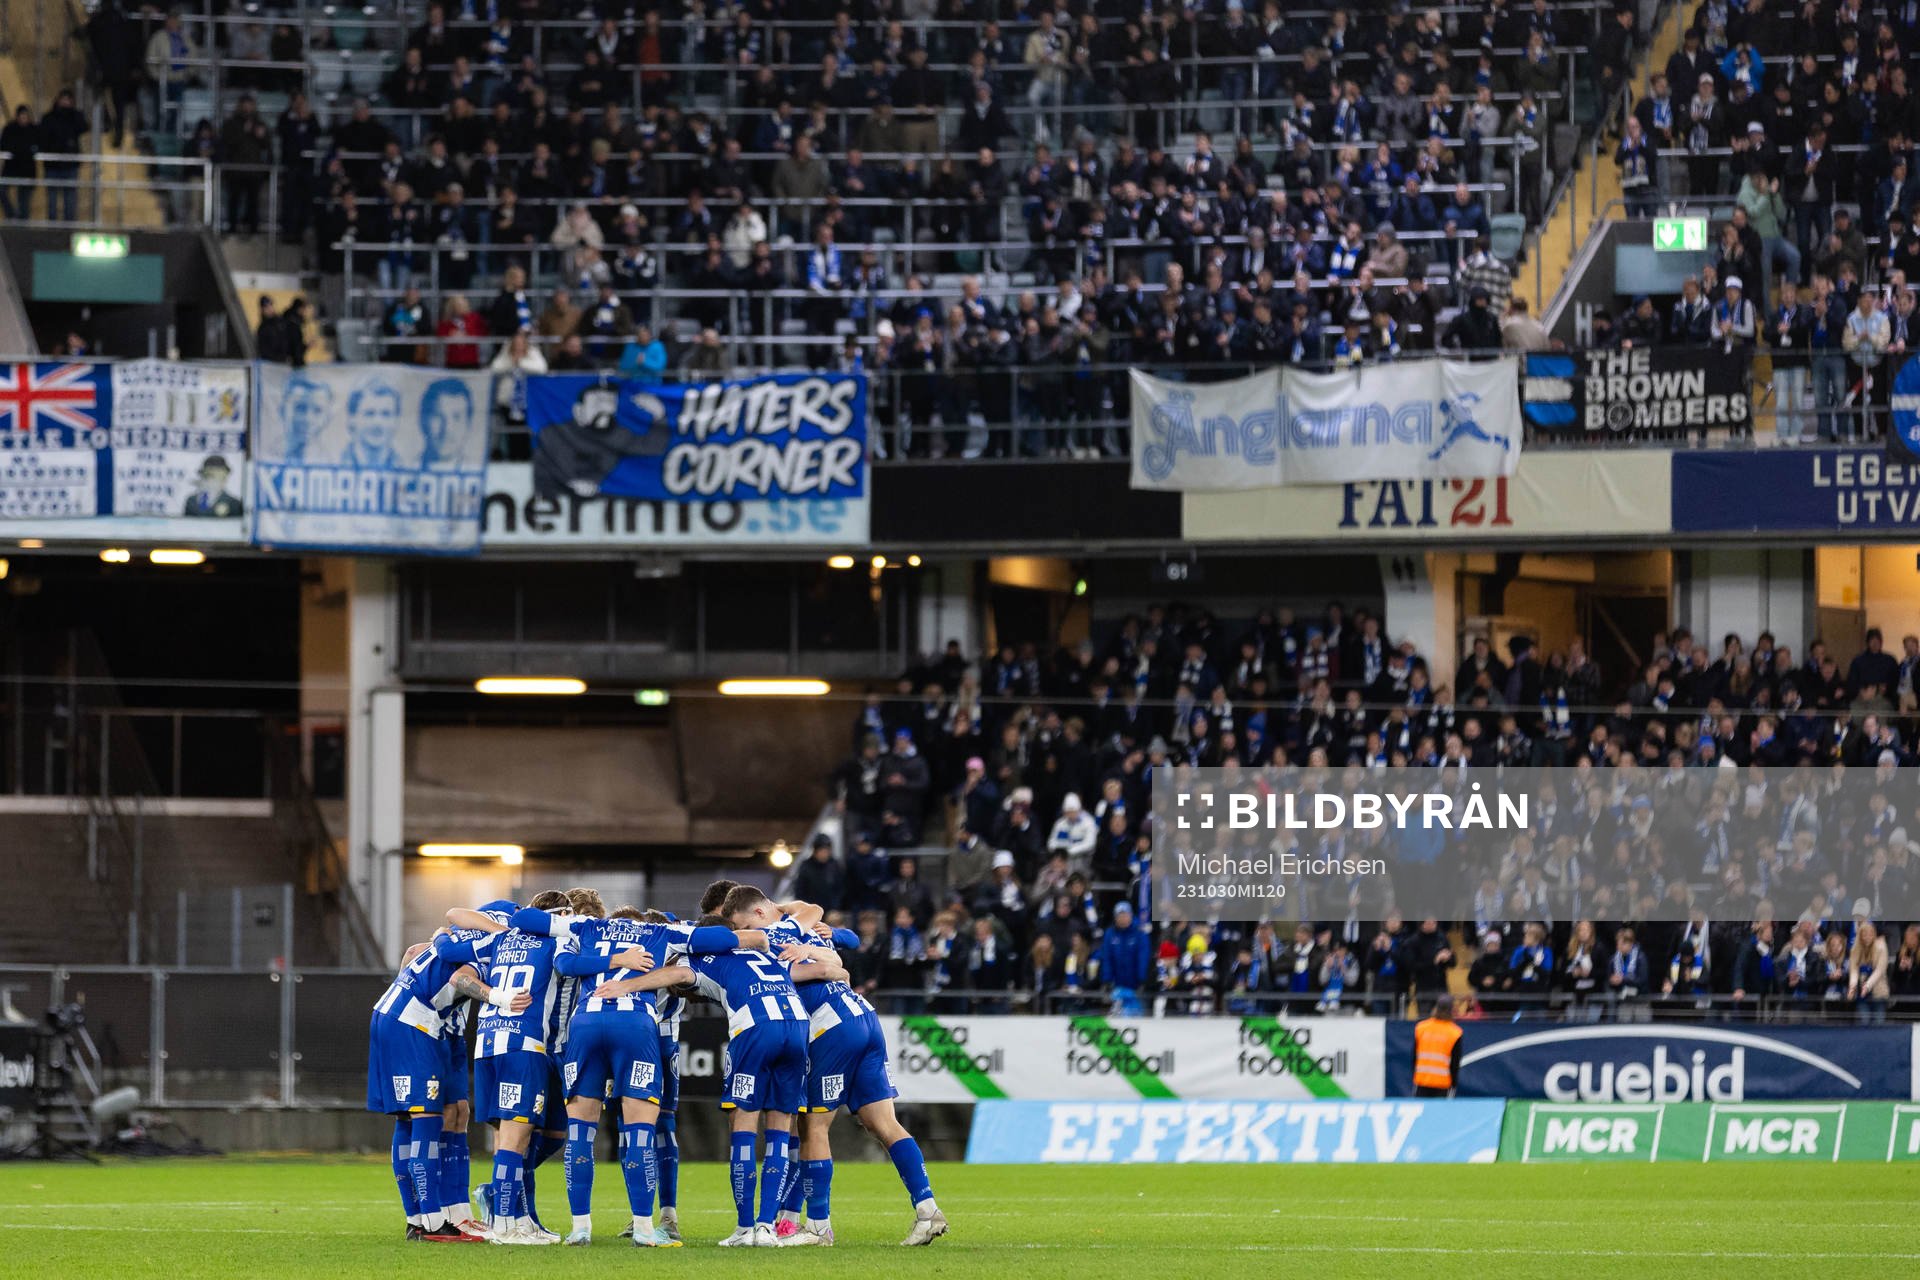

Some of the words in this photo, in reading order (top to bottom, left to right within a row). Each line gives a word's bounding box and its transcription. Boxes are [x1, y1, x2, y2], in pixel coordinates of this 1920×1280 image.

[1586, 348, 1651, 376] THE
[1585, 369, 1705, 401] BROWN
[677, 378, 857, 439] HATERS
[1585, 395, 1748, 431] BOMBERS
[663, 437, 863, 496] CORNER
[601, 931, 642, 943] WENDT
[899, 1019, 969, 1048] forza
[1066, 1019, 1139, 1048] forza
[1238, 1019, 1311, 1048] forza
[898, 1048, 1004, 1075] football
[1066, 1048, 1175, 1076] football
[1238, 1048, 1348, 1077] football
[1543, 1044, 1745, 1102] cuebid
[1040, 1103, 1424, 1162] EFFEKTIV
[1543, 1117, 1639, 1154] MCR
[1724, 1117, 1821, 1154] MCR
